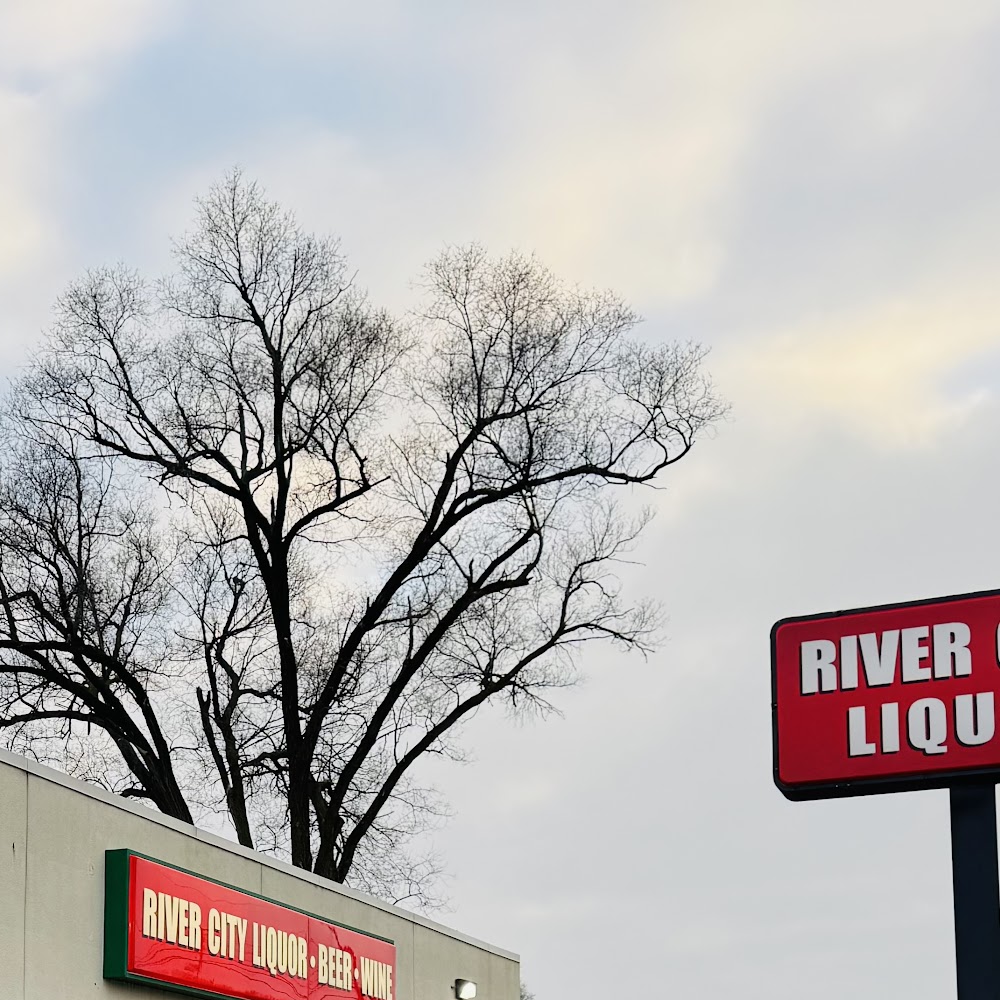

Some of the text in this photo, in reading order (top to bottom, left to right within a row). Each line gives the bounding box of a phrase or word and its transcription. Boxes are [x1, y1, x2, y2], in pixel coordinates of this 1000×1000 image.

[801, 622, 972, 695] RIVER
[848, 692, 995, 757] LIQU
[142, 888, 201, 950] RIVER
[207, 908, 247, 963] CITY
[252, 922, 307, 980] LIQUOR
[318, 944, 352, 991] BEER
